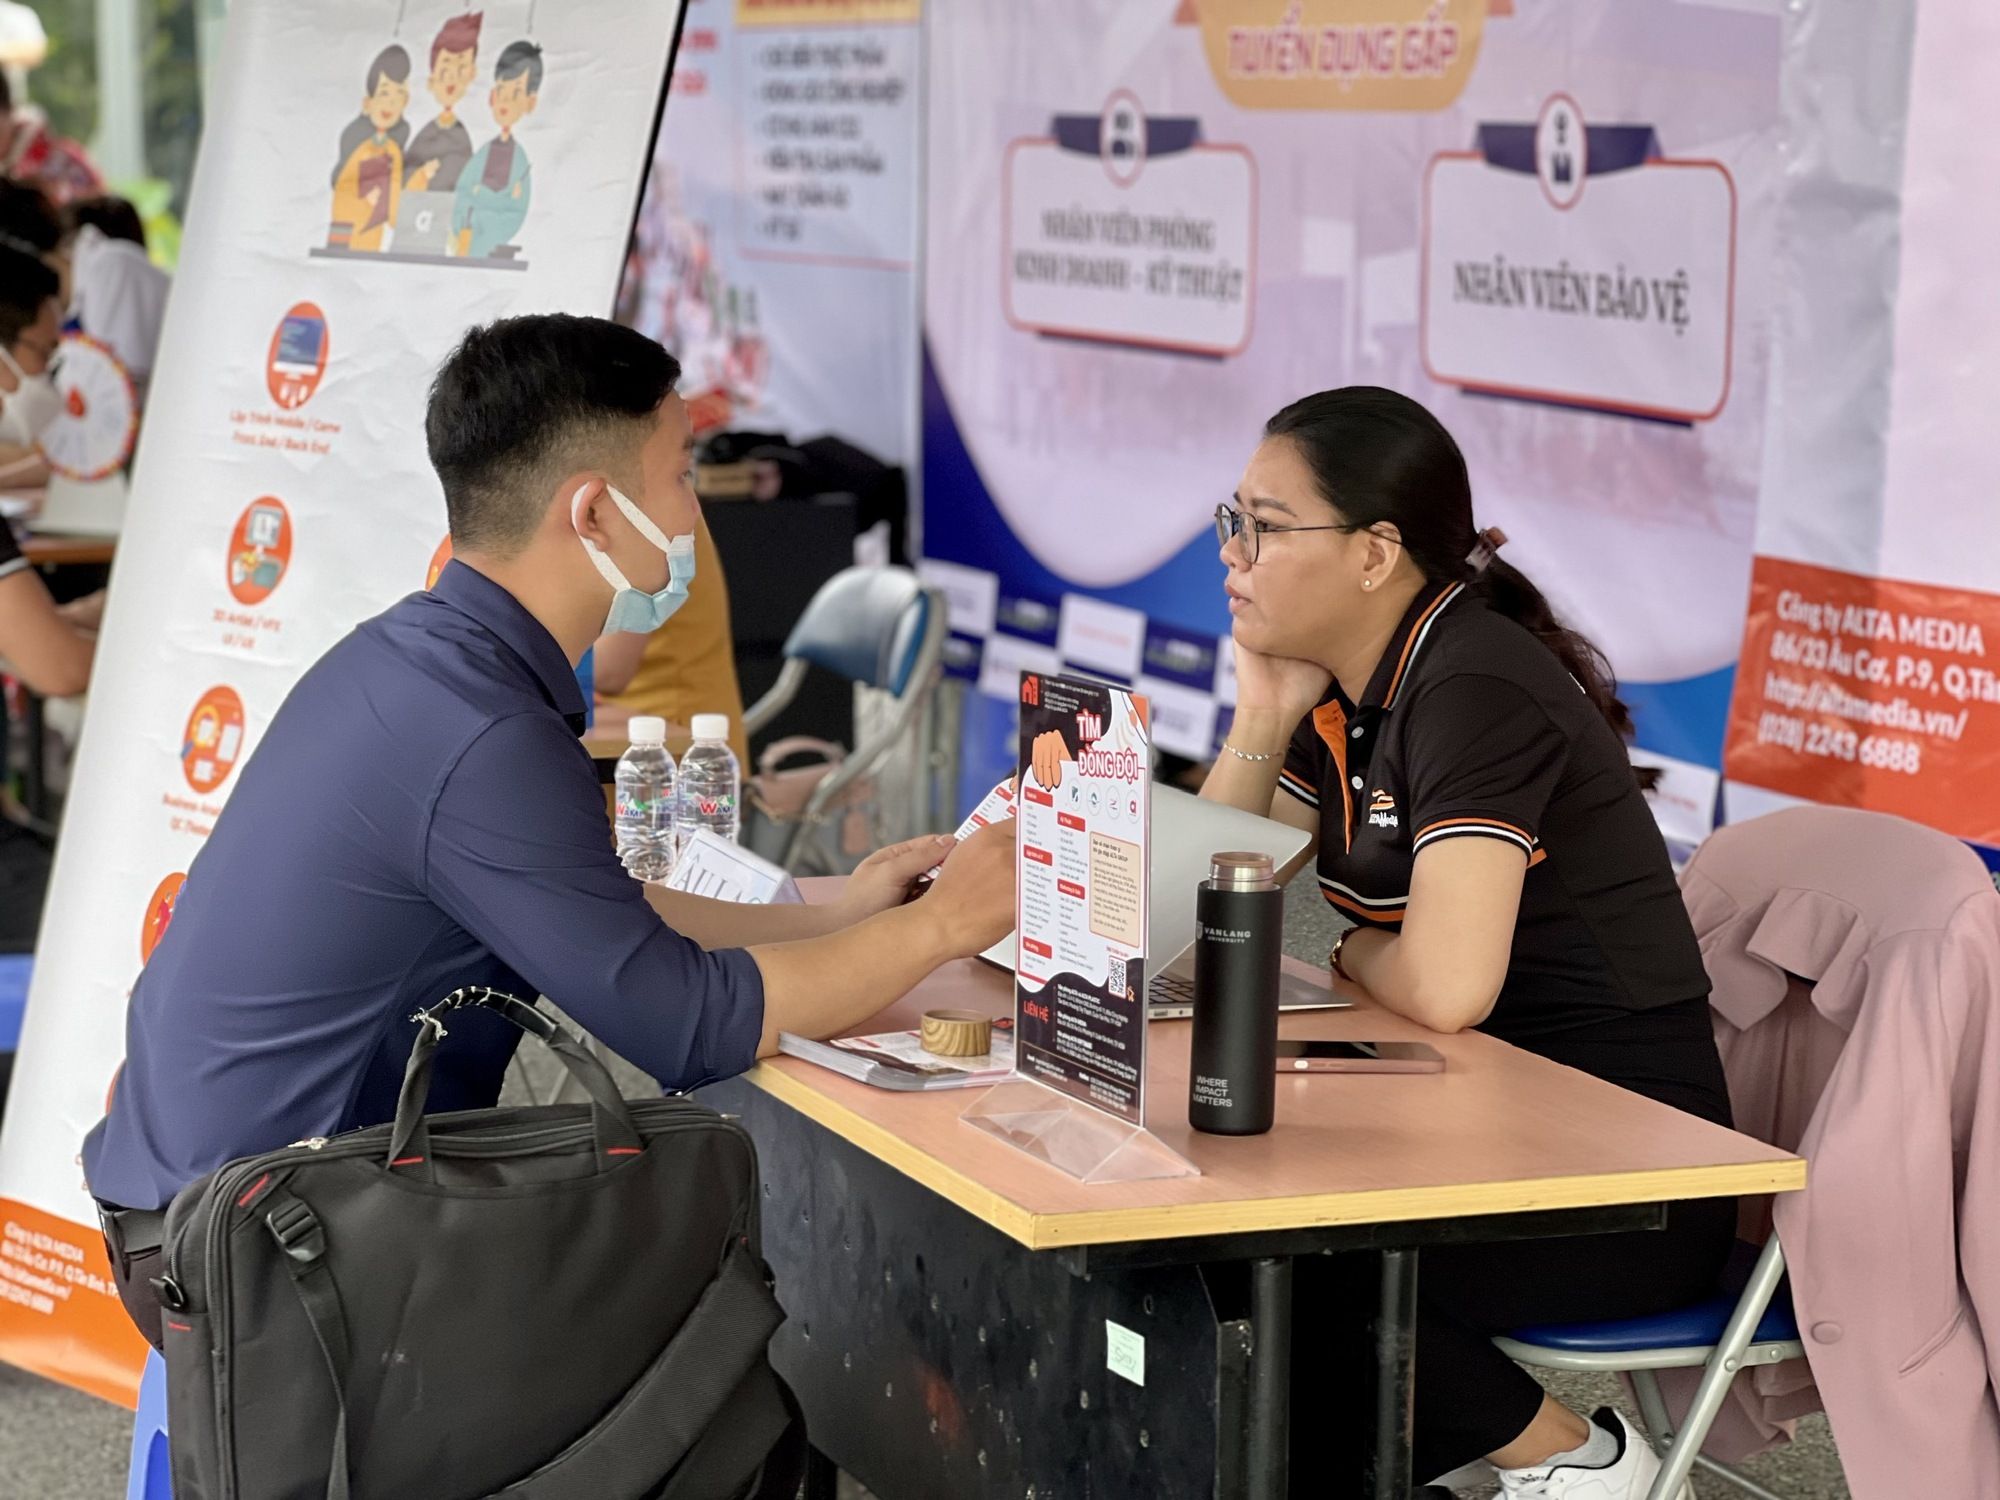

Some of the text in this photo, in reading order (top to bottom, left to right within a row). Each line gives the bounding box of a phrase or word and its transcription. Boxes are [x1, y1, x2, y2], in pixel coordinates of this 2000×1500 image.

[1318, 25, 1395, 92] DỤNG
[1453, 253, 1692, 337] NHÂN VIÊN BẢO VỆ
[1777, 590, 1824, 633] Công
[1841, 604, 1898, 643] ALTA
[1899, 614, 1985, 657] MEDIA
[1896, 654, 1939, 696] P.9,
[1077, 708, 1102, 741] TÌM
[1078, 744, 1139, 785] ĐỒNG ĐỘI
[1805, 722, 1859, 762] 2243
[1859, 735, 1921, 775] 6888
[1205, 927, 1251, 938] VANLANG
[1207, 935, 1245, 944] UNIVERSITY
[1024, 1000, 1039, 1018] LIÊN
[1040, 1006, 1049, 1024] HỆ
[1195, 1084, 1229, 1098] IMPACT
[1196, 1075, 1228, 1088] WHERE
[1192, 1093, 1233, 1108] MATTERS
